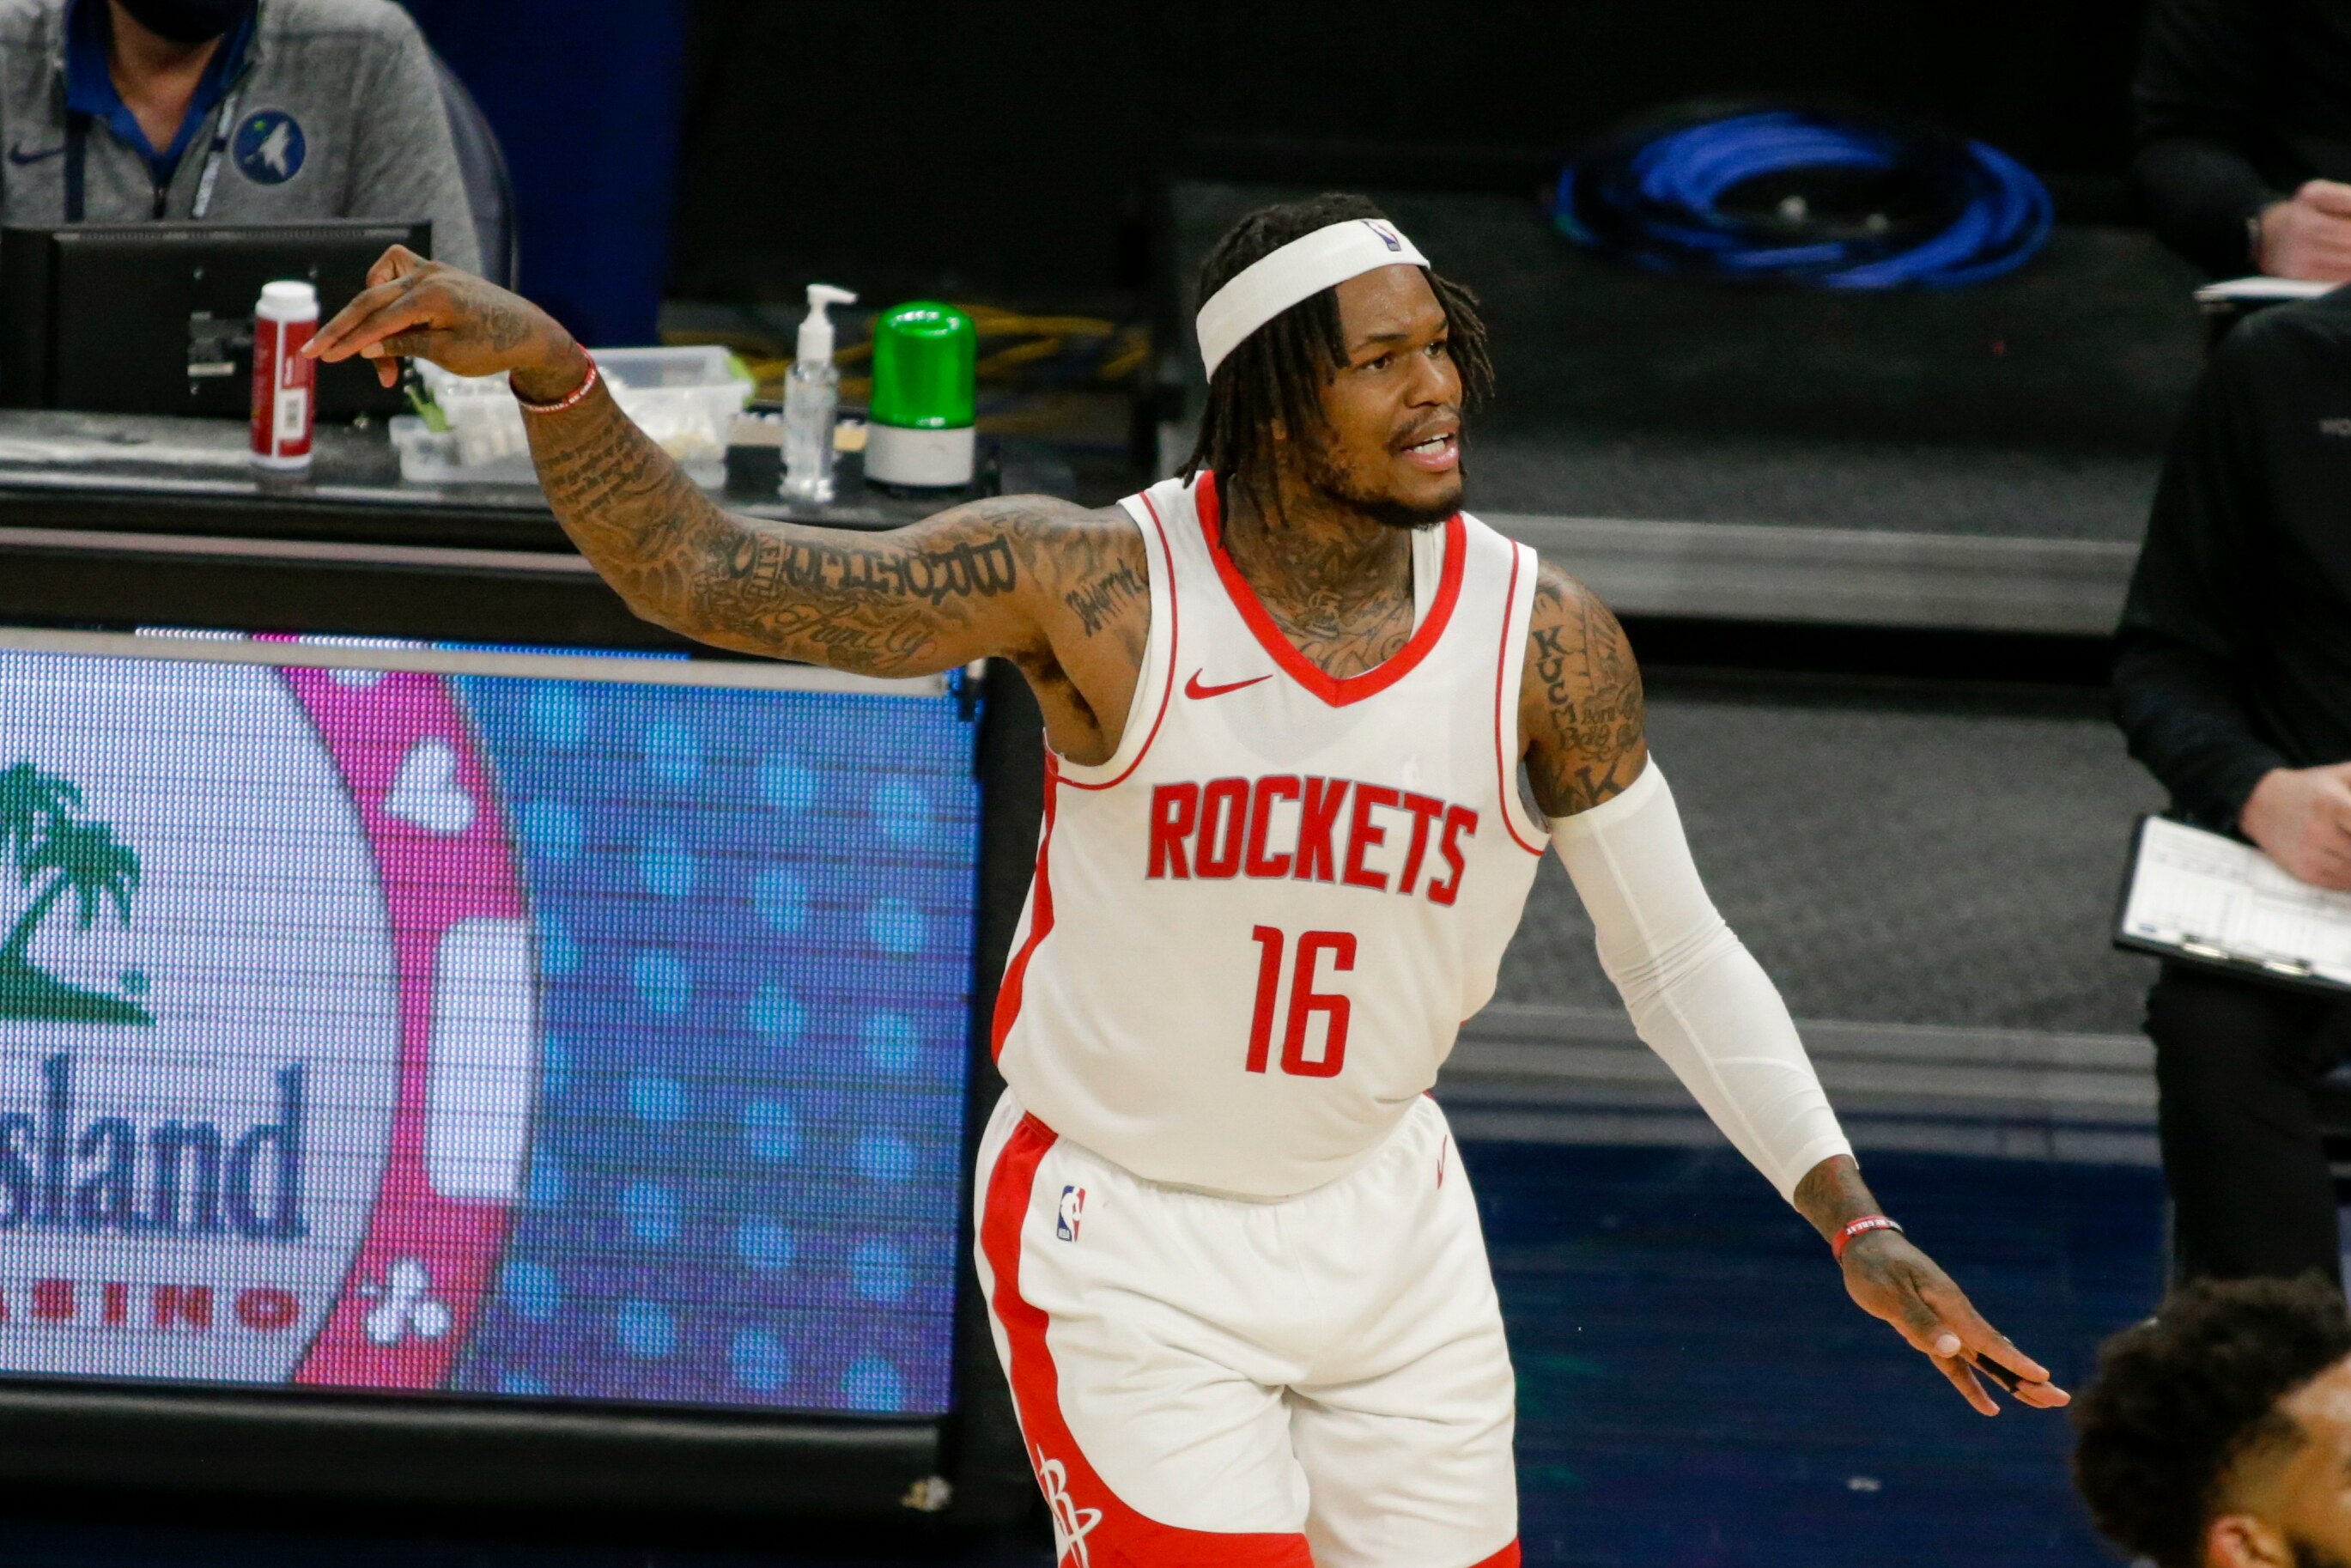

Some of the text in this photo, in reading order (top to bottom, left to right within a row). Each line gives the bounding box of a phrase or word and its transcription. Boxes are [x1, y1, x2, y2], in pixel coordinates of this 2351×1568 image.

[1145, 774, 1479, 907] ROCKETS
[1246, 925, 1357, 1078] 16
[0, 1279, 300, 1331] SINO
